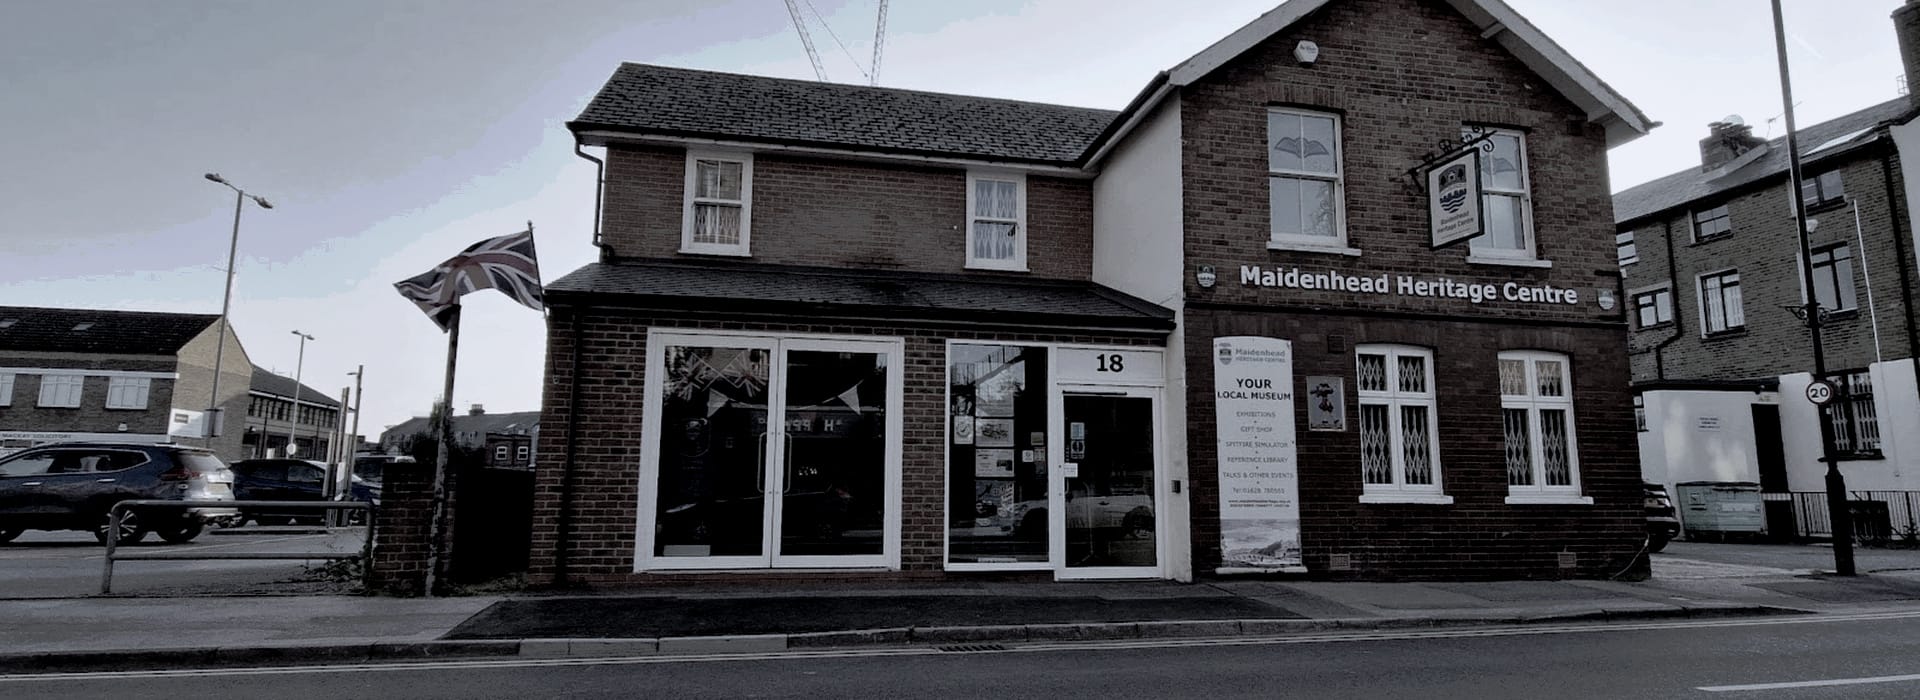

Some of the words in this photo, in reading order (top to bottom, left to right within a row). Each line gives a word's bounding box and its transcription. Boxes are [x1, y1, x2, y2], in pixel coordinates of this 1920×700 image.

[1240, 265, 1389, 294] Maidenhead
[1396, 276, 1497, 304] Heritage
[1502, 282, 1578, 304] Centre
[1235, 348, 1285, 358] Maidenhead
[1096, 353, 1124, 373] 18
[1236, 378, 1272, 389] YOUR
[1217, 390, 1248, 400] LOCAL
[1251, 391, 1291, 401] MUSEUM
[1810, 387, 1829, 398] 20
[1254, 441, 1288, 449] SIMULATOR
